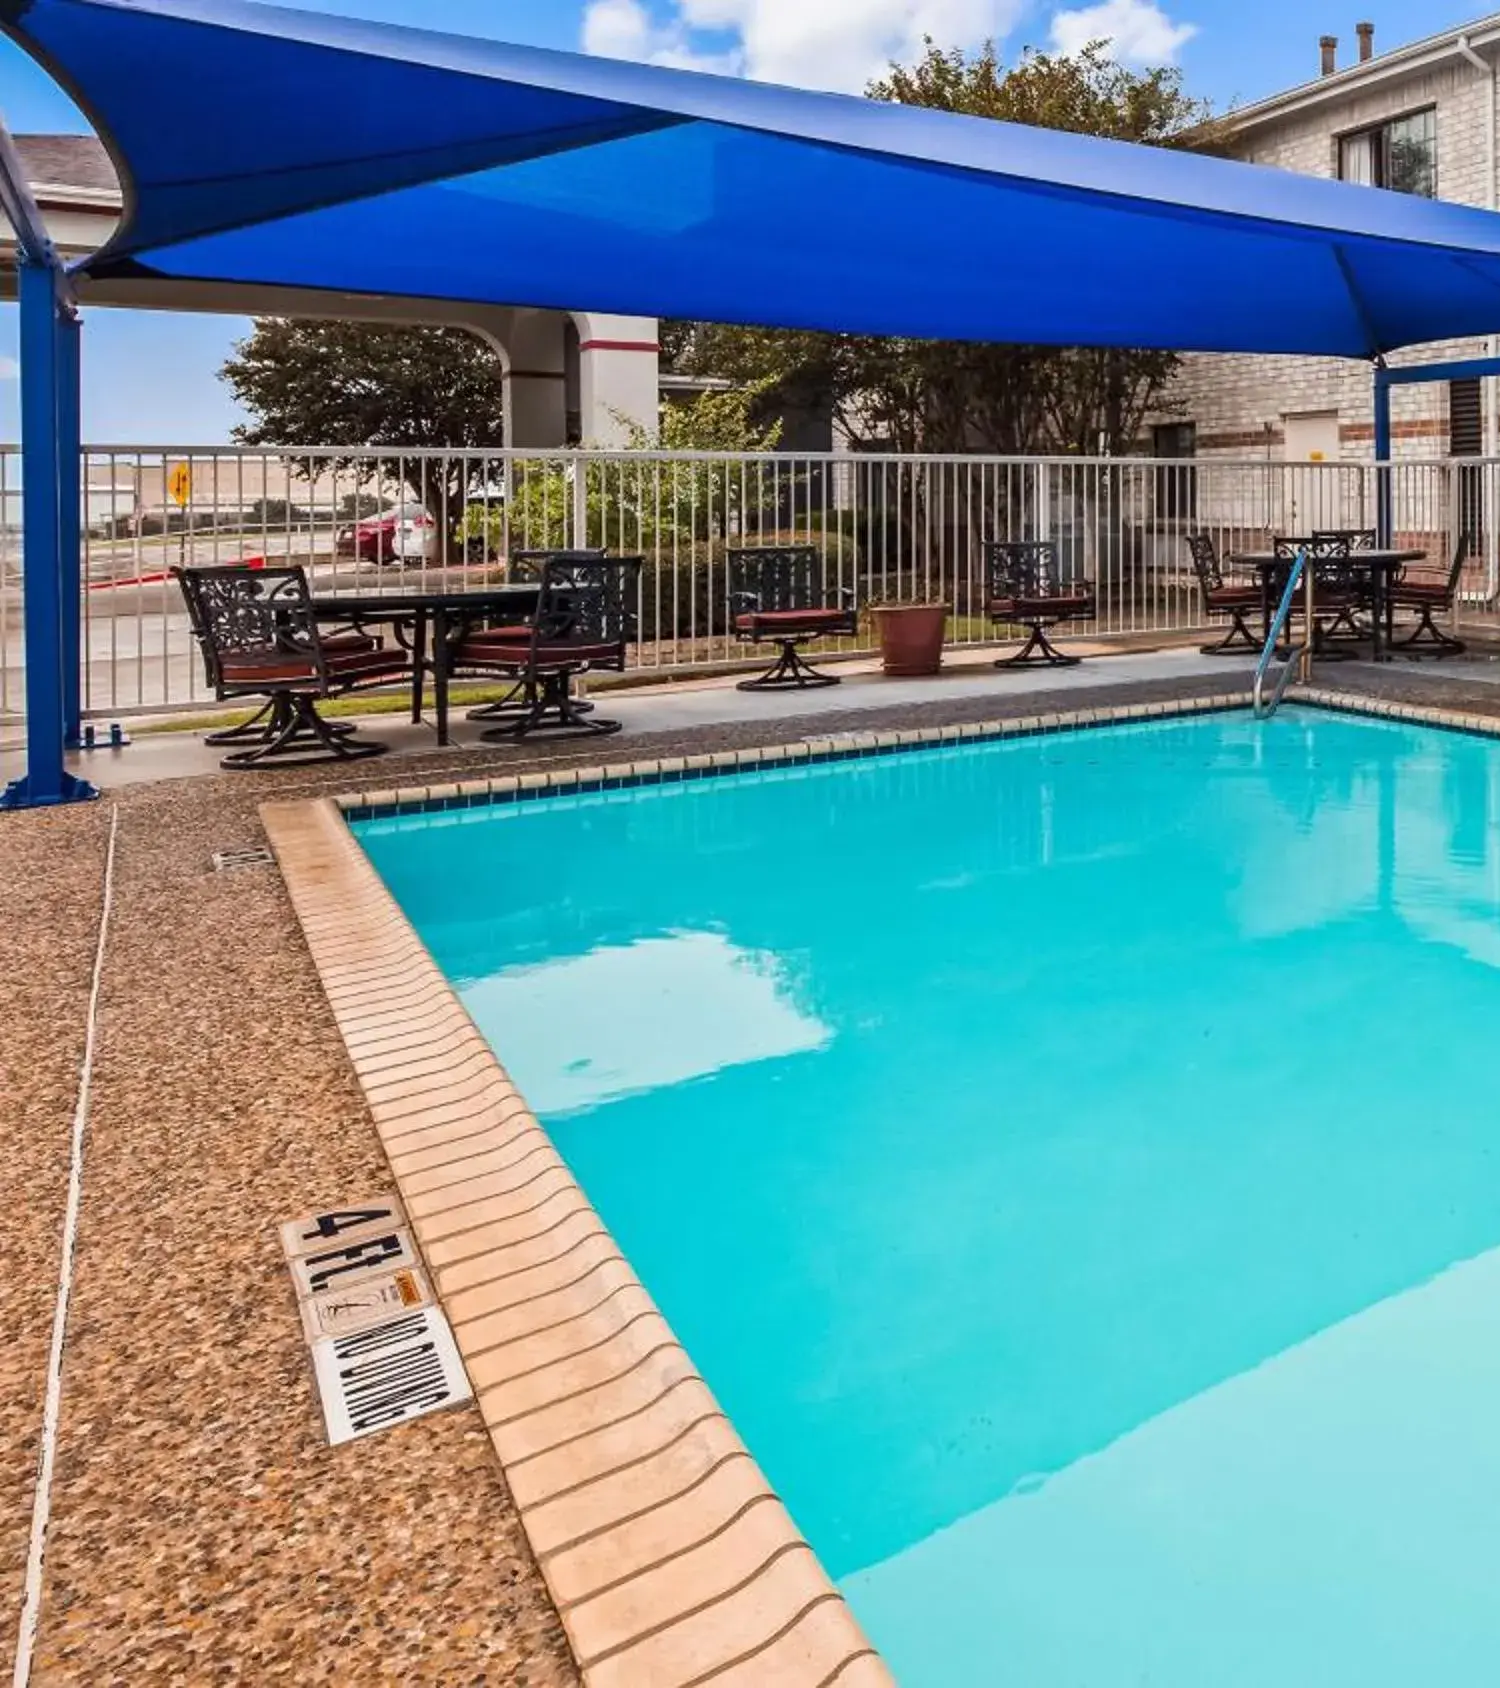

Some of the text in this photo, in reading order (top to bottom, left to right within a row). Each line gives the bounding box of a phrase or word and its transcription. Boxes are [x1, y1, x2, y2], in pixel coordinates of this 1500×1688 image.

[303, 1209, 391, 1240] 4
[334, 1313, 450, 1431] NO DIVING
